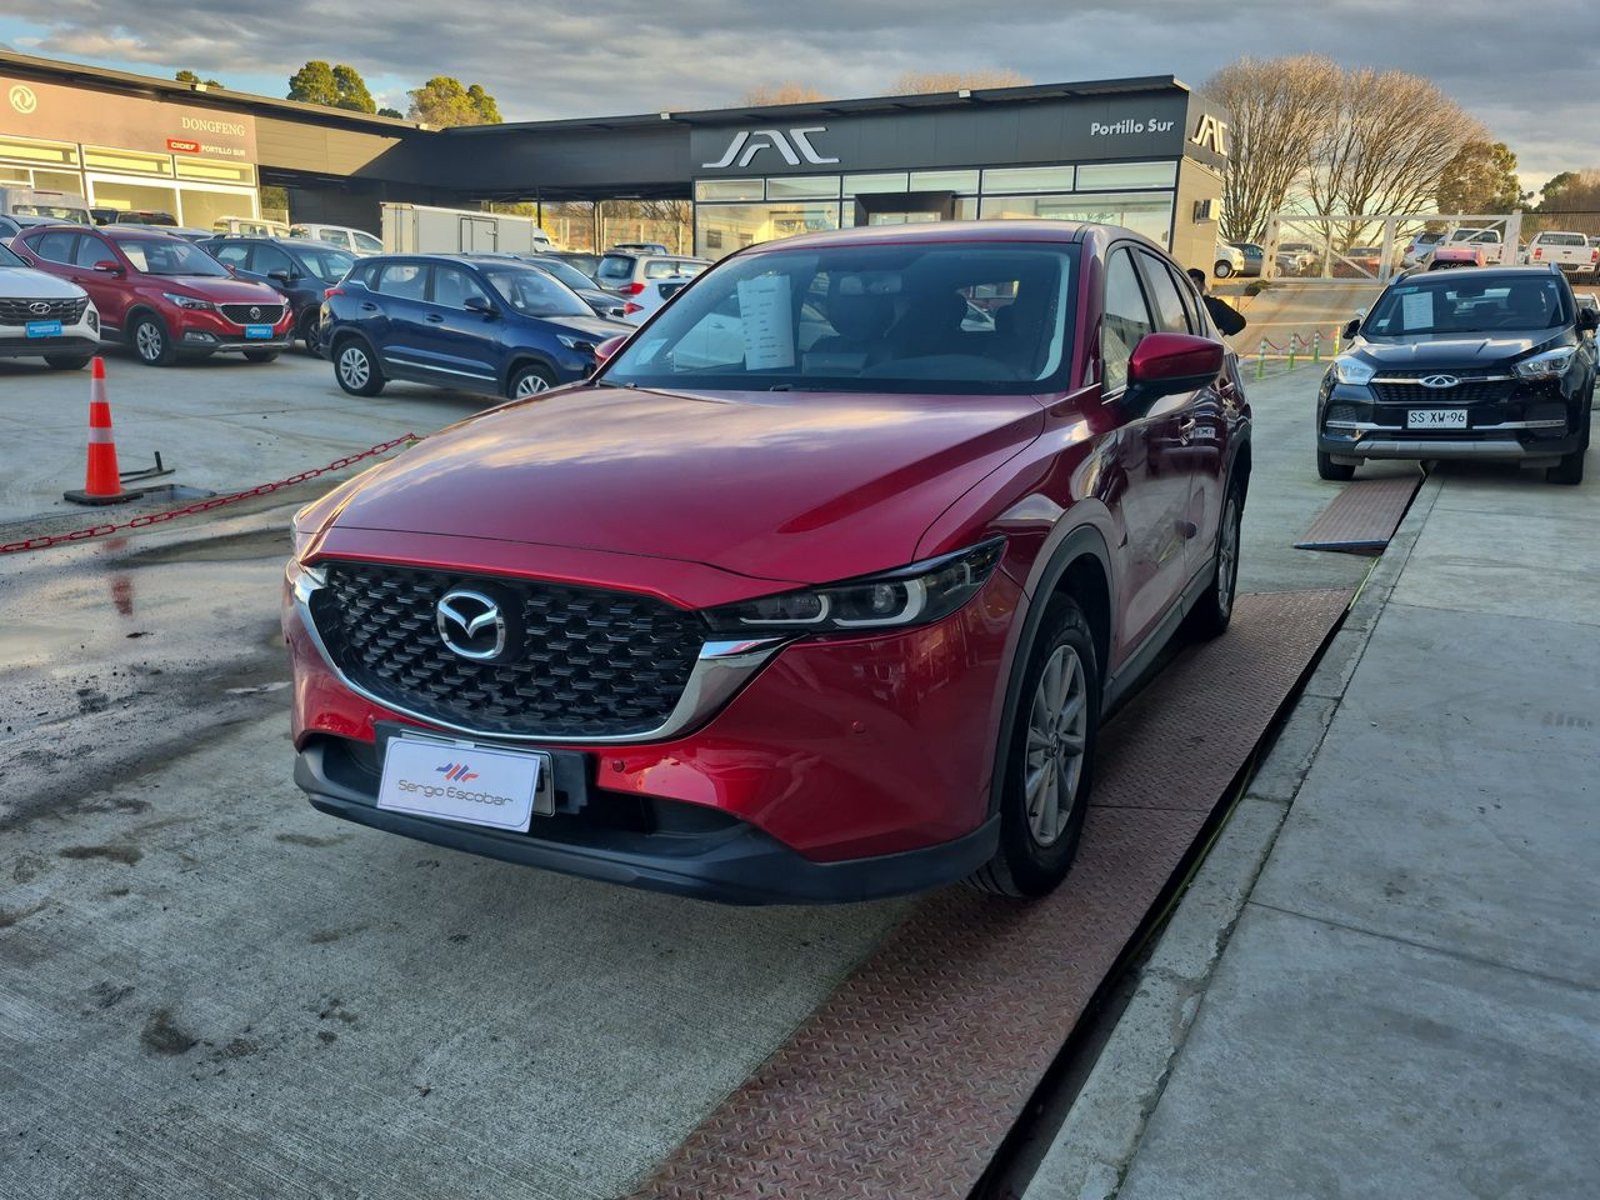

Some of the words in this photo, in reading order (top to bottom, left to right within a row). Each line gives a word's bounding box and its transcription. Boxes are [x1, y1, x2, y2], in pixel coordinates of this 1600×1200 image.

[182, 117, 245, 136] DONGFENG
[1091, 119, 1144, 135] Portillo
[1148, 118, 1174, 132] Sur
[170, 142, 196, 150] CIDEF
[201, 145, 231, 153] PORTILLO
[702, 127, 840, 168] JAC
[1409, 412, 1425, 423] SS
[398, 780, 444, 798] Sergo
[447, 787, 513, 806] Escobar
